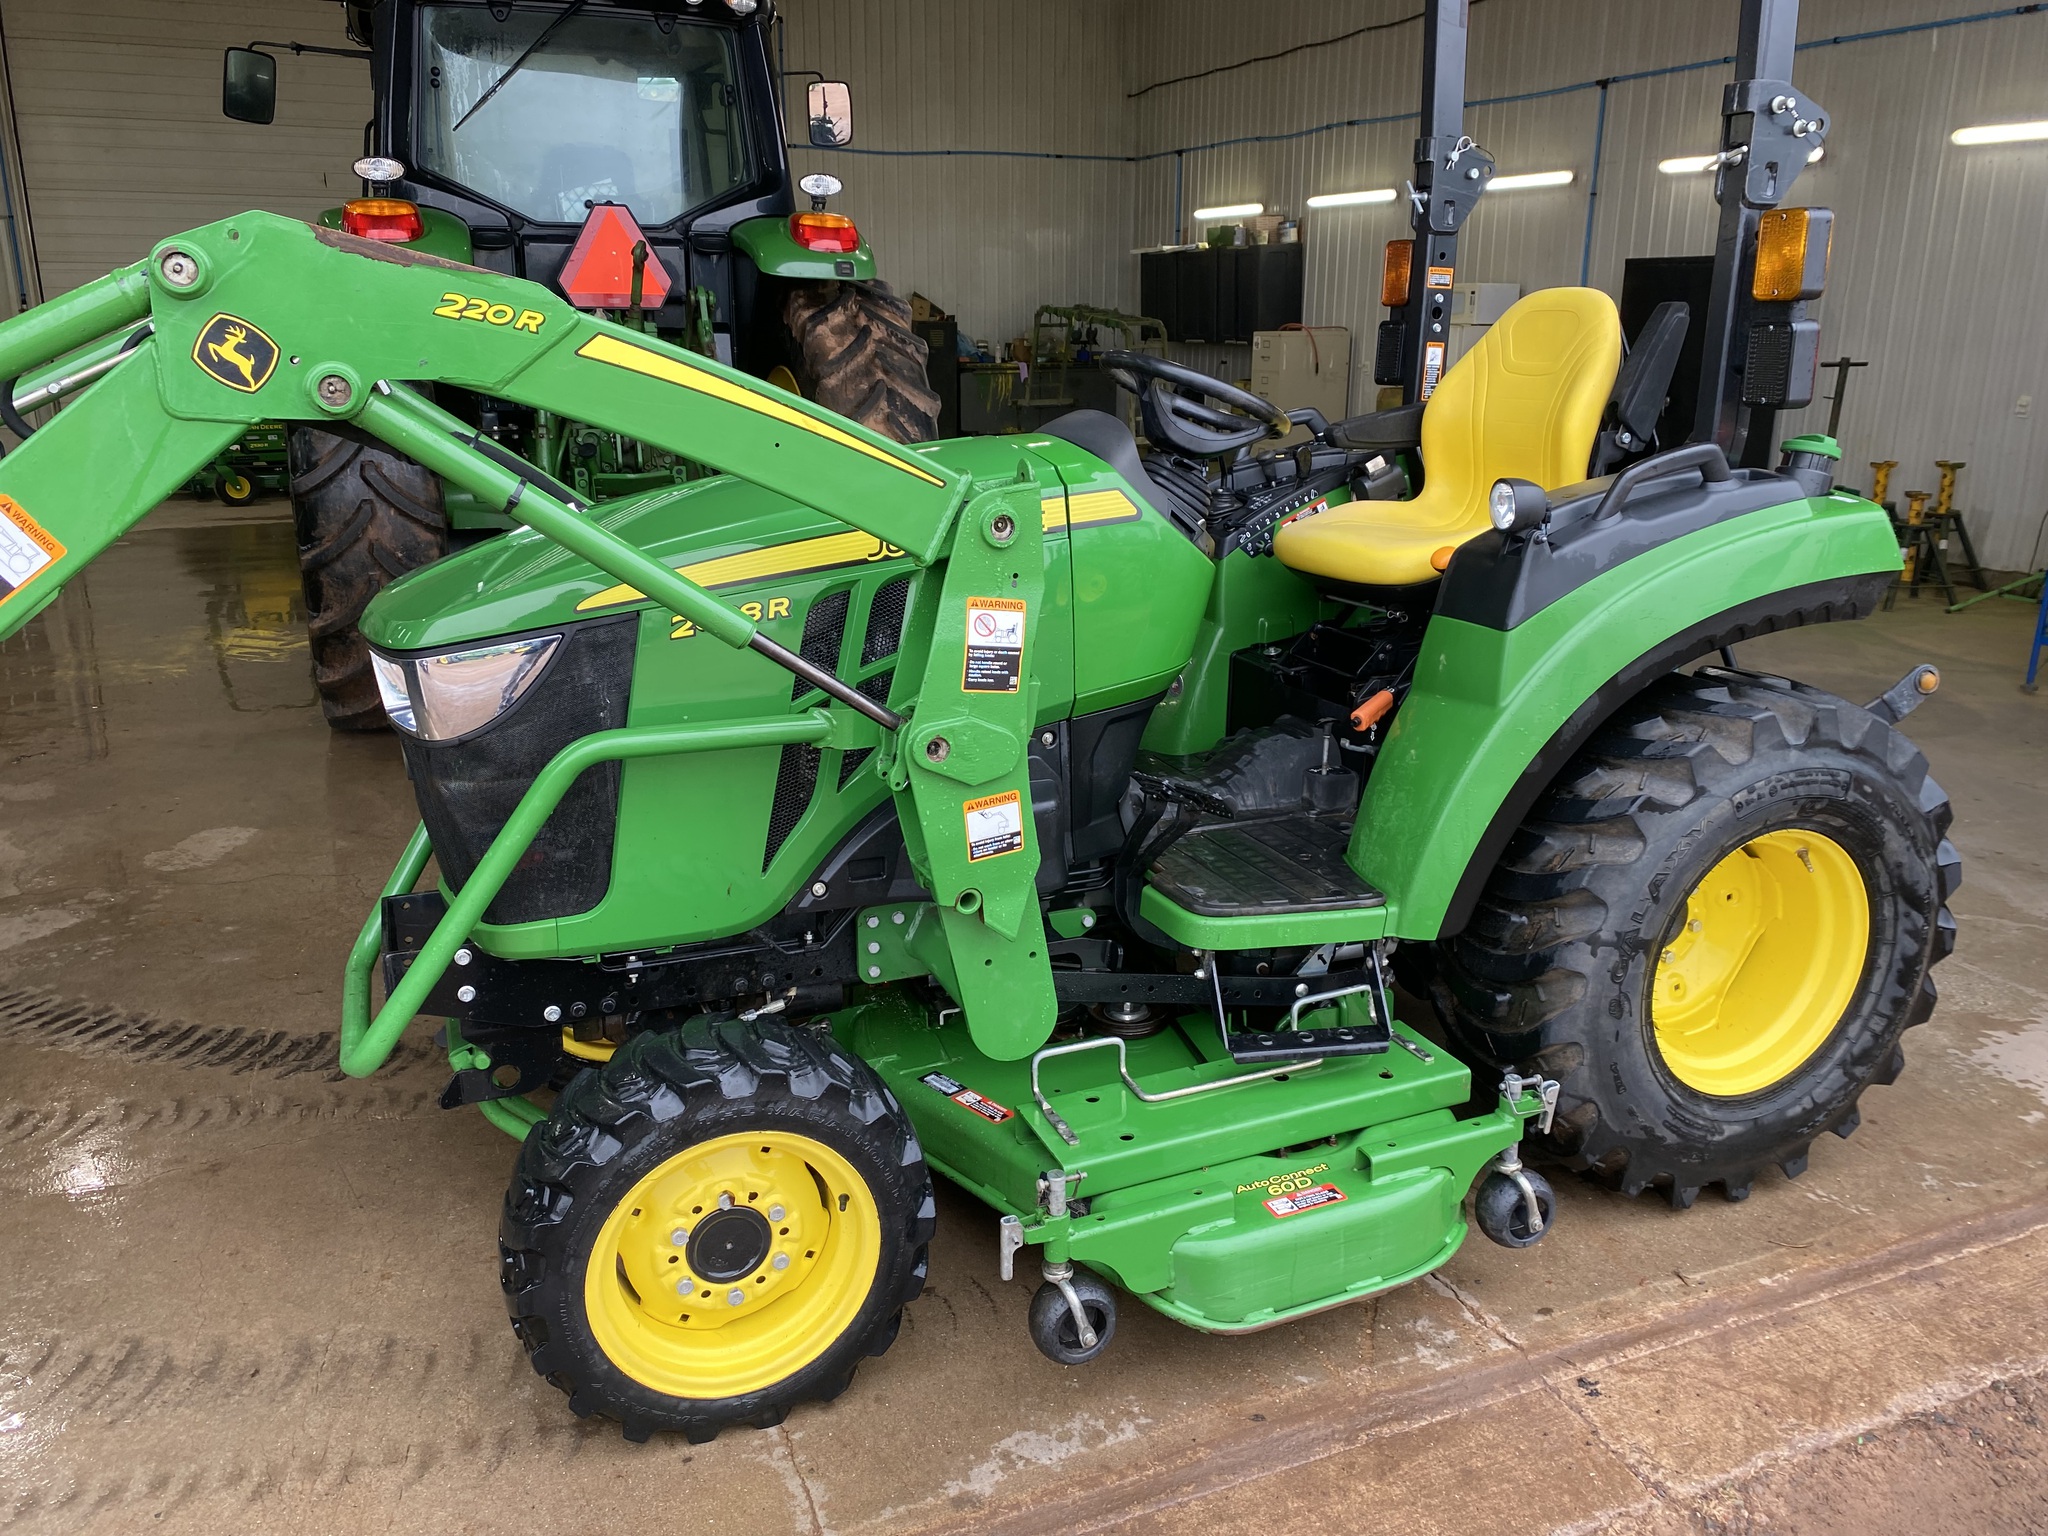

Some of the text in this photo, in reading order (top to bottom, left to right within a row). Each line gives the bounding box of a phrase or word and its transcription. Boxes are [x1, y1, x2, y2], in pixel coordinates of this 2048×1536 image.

[12, 510, 56, 552] WARNING
[979, 599, 1023, 610] WARNING
[670, 596, 792, 640] 28R
[974, 792, 1017, 809] WARNING
[1235, 1163, 1330, 1195] AutoConnect
[1267, 1176, 1313, 1197] 60D
